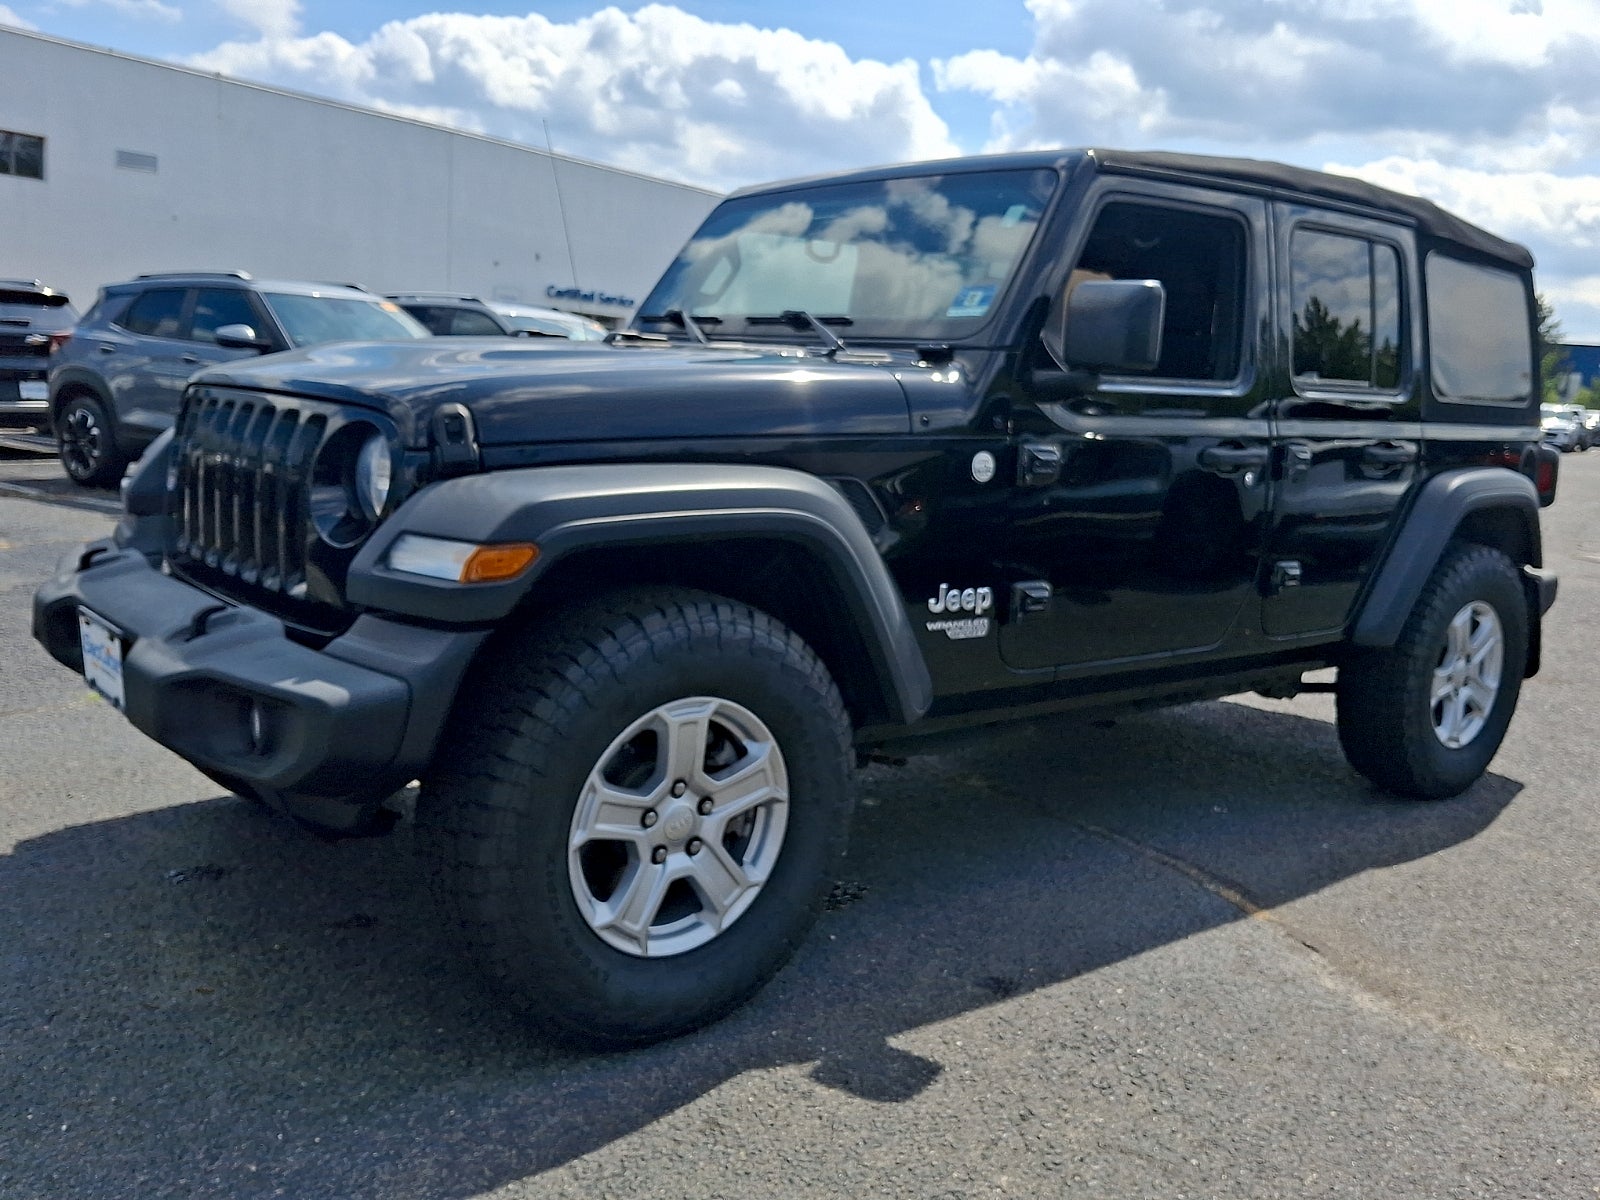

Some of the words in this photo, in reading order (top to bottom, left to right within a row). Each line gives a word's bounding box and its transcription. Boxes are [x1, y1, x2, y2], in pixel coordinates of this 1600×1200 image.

[547, 285, 594, 301] Certified
[599, 292, 634, 306] Service
[928, 583, 992, 615] Jeep
